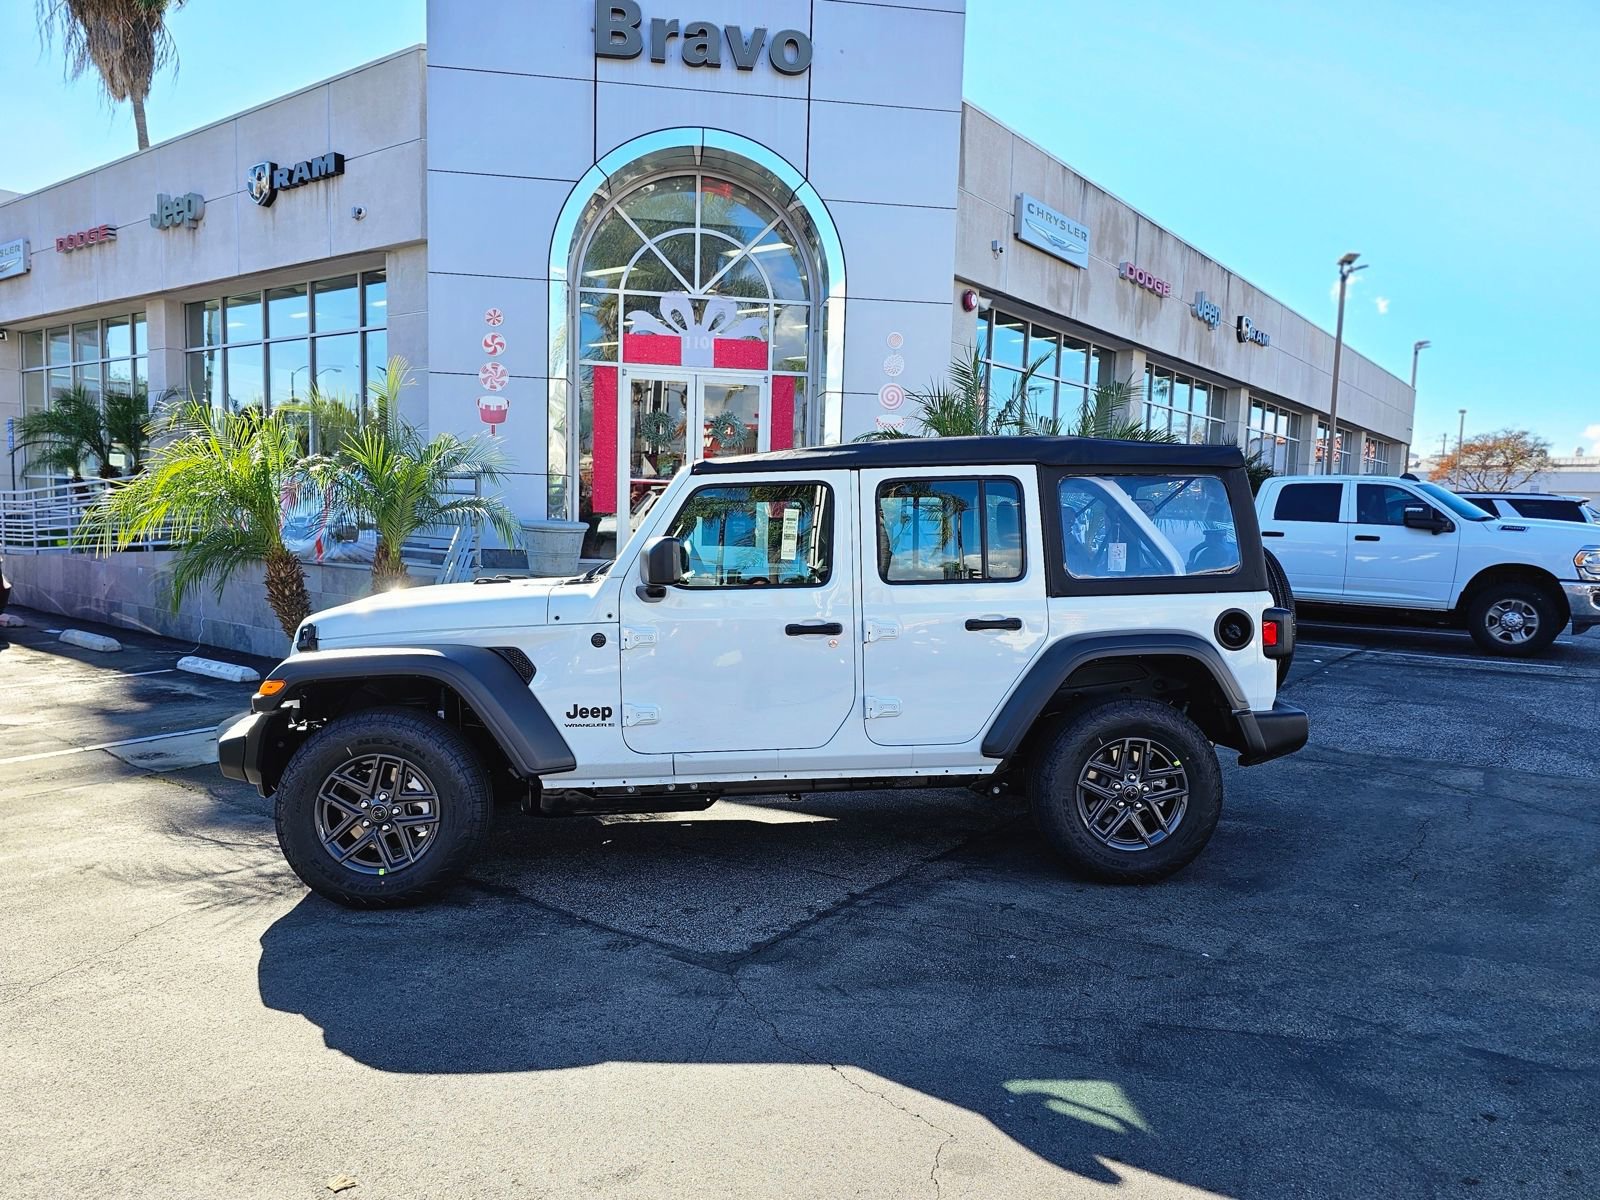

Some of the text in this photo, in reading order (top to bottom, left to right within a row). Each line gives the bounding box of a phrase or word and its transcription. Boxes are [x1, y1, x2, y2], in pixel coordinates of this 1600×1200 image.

[595, 0, 813, 76] Bravo
[273, 152, 342, 190] RAM
[150, 192, 204, 230] Jeep
[1027, 203, 1088, 242] CHRYSLER
[56, 224, 115, 254] DODGE
[1123, 262, 1172, 298] DODGE
[1192, 291, 1222, 331] Jeep
[1250, 327, 1271, 347] RAM
[565, 703, 613, 721] Jeep
